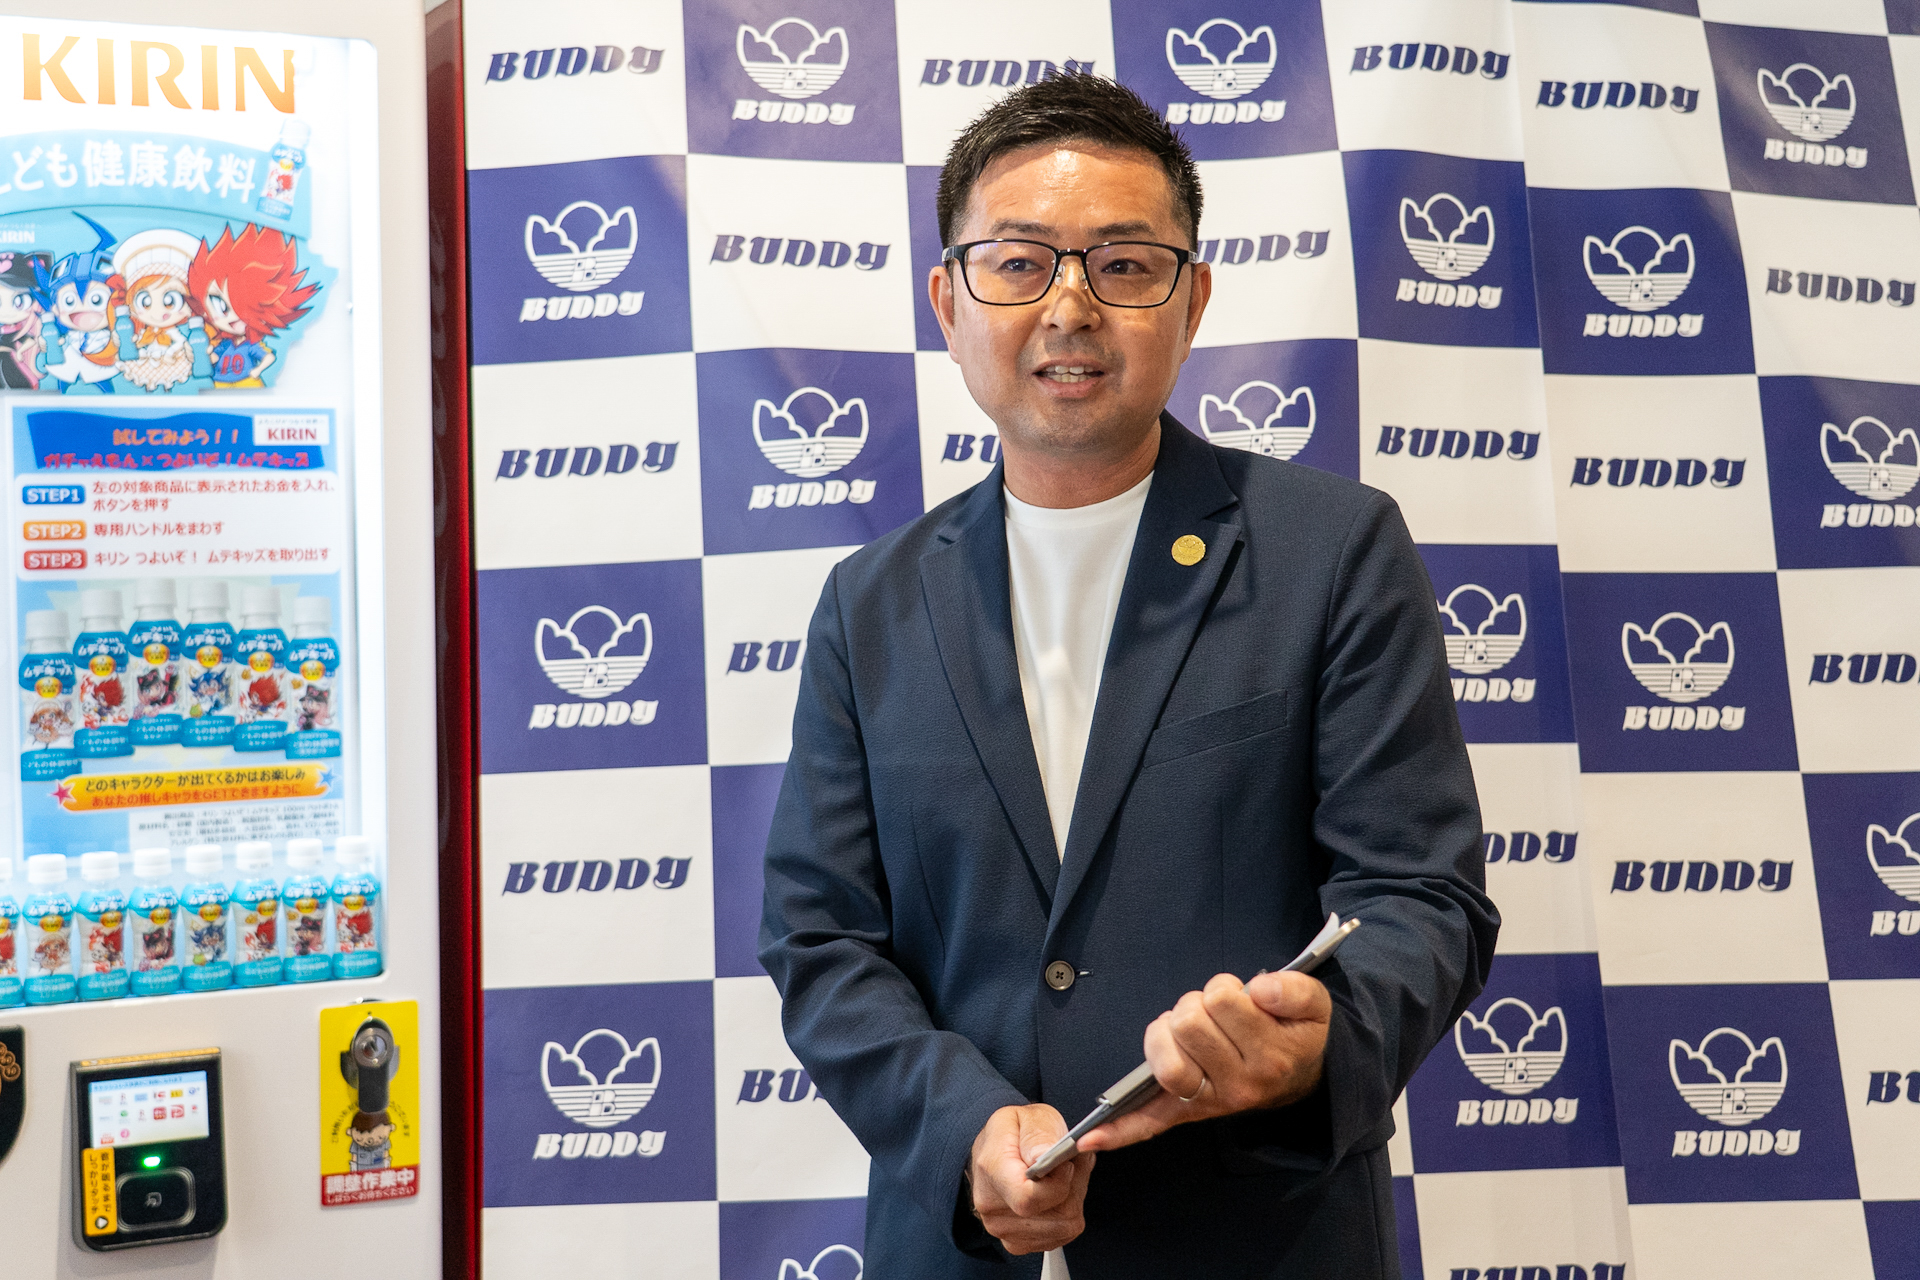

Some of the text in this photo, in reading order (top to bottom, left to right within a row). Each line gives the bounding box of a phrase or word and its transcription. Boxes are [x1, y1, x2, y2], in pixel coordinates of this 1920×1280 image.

[22, 33, 295, 114] KIRIN
[486, 46, 663, 83] BUDDY
[1351, 43, 1510, 80] BUDDY
[1537, 81, 1699, 113] BUDDY
[733, 99, 856, 125] BUDDY
[1166, 100, 1286, 124] BUDDY
[1764, 138, 1867, 168] BUDDY
[710, 235, 890, 271] BUDDY
[1396, 278, 1502, 309] BUDDY
[1766, 269, 1915, 306] BUDDY
[520, 291, 645, 322] BUDDY
[1583, 313, 1703, 337] BUDDY
[221, 354, 244, 375] 10
[267, 428, 317, 442] KIRIN
[1376, 426, 1540, 460] BUDDY
[496, 442, 678, 480] BUDDY
[1571, 458, 1746, 487] BUDDY
[26, 485, 80, 504] STEP1
[93, 497, 171, 512] ボタンを押す
[748, 479, 876, 510] BUDDY
[94, 521, 225, 537] 専用ハンドルをまわす
[1820, 503, 1920, 529] BUDD
[27, 523, 82, 540] STEP2
[28, 552, 83, 568] STEP3
[94, 551, 130, 566] キリン
[207, 548, 331, 564] ムテキッズを取り出す
[1807, 654, 1920, 687] BUD
[529, 700, 658, 729] BUDDY
[1623, 706, 1745, 730] BUDDY
[85, 769, 305, 792] どのキャラクターが出てくるかはお楽しみ
[502, 857, 691, 895] BUDDY
[1611, 860, 1793, 893] BUDDY
[737, 1067, 825, 1105] BU
[1456, 1098, 1578, 1126] BUDDY
[533, 1131, 666, 1159] BUDDY
[1672, 1129, 1801, 1157] BUDDY
[326, 1168, 415, 1194] 調整作業中
